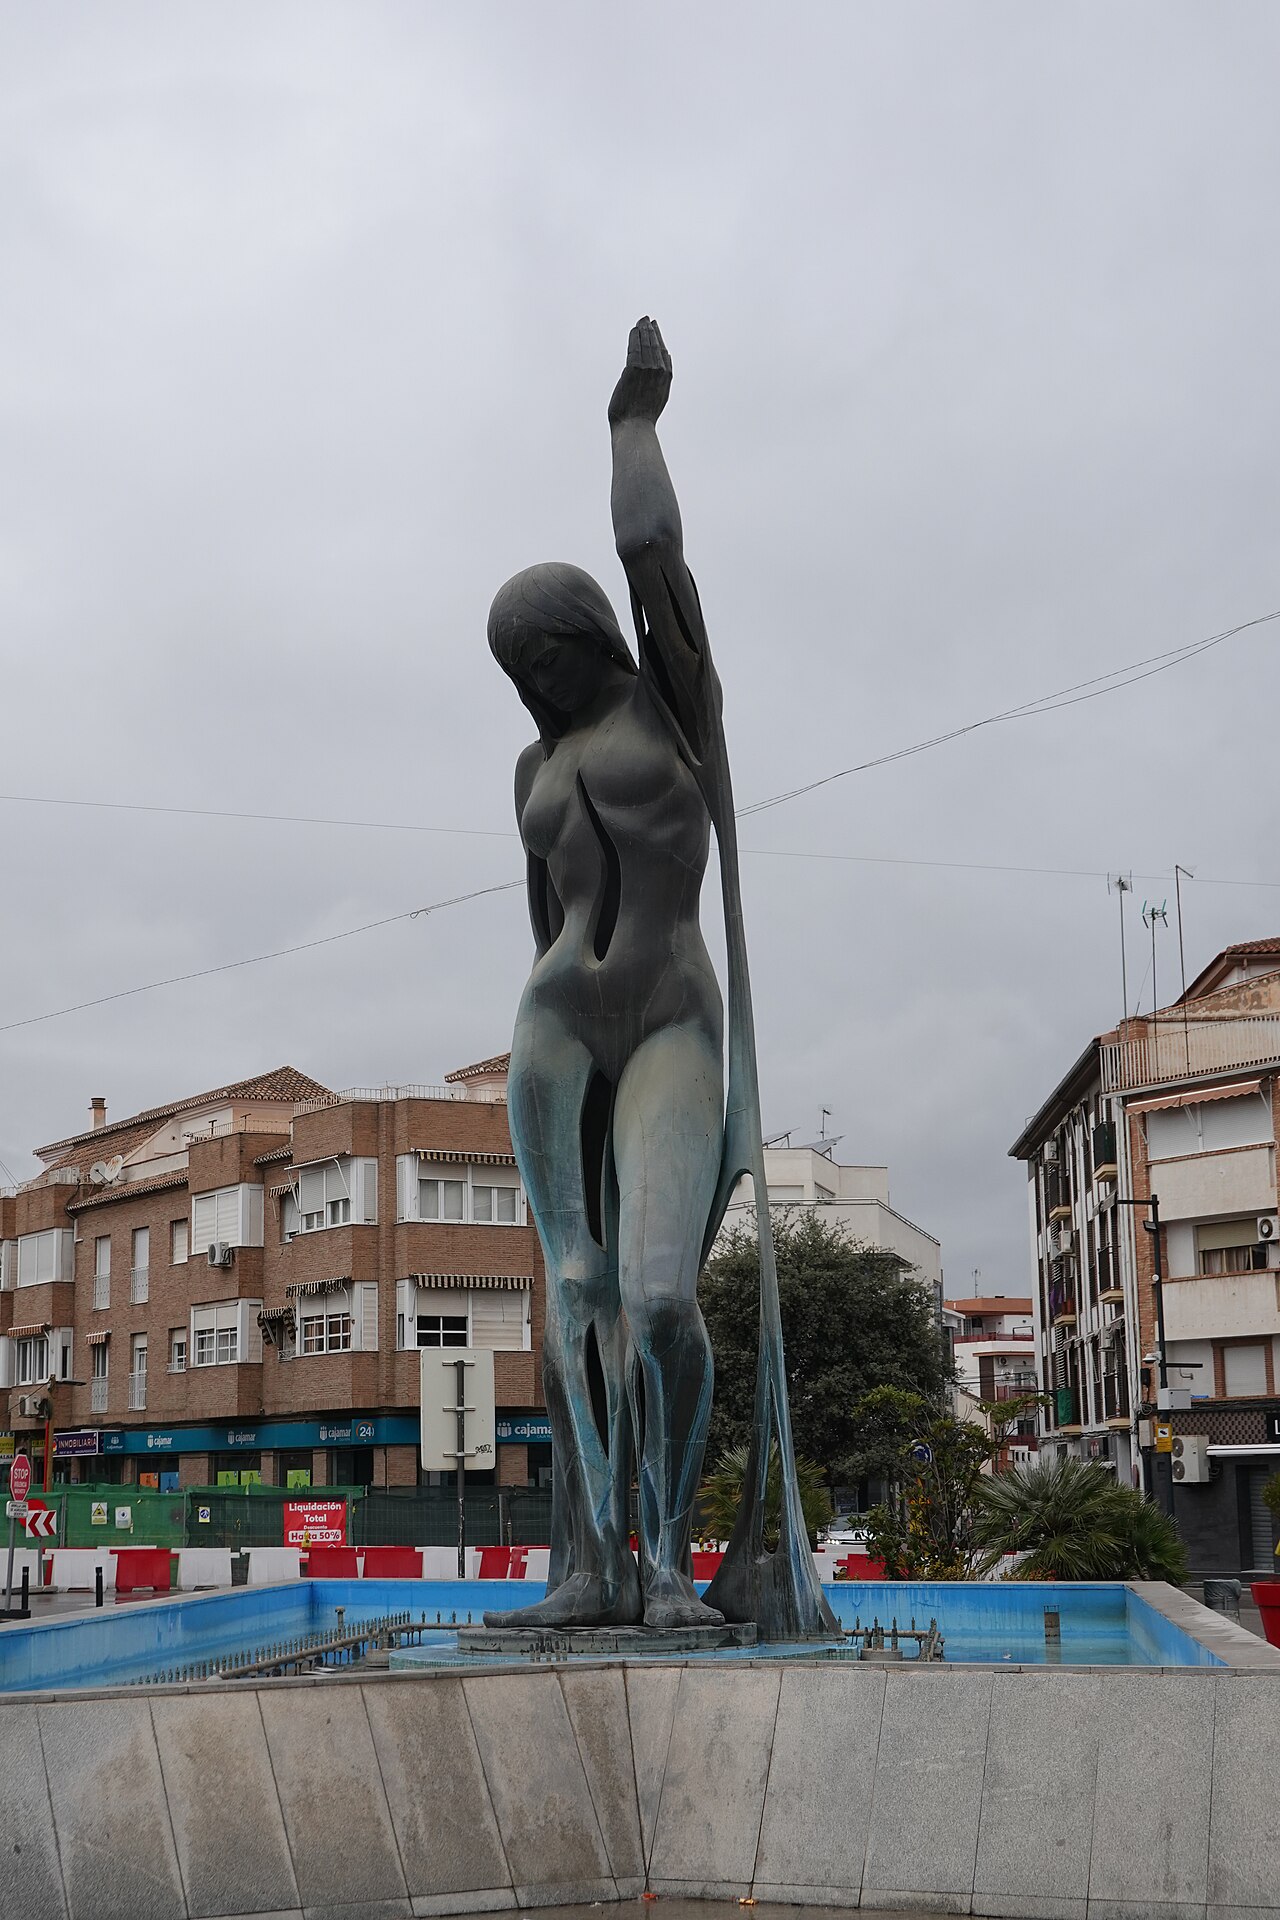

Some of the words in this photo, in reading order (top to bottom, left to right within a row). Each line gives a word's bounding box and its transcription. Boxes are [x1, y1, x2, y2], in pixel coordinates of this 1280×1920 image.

[328, 1426, 351, 1440] cajamar
[514, 1422, 552, 1437] cajama
[58, 1437, 96, 1448] INMOBILIARIA
[154, 1435, 172, 1448] cajamar
[235, 1432, 256, 1444] cajamar
[13, 1468, 29, 1479] STOP
[289, 1502, 341, 1513] Liquidación
[304, 1514, 327, 1522] Total
[291, 1532, 318, 1541] Hata
[319, 1531, 340, 1540] 50%
